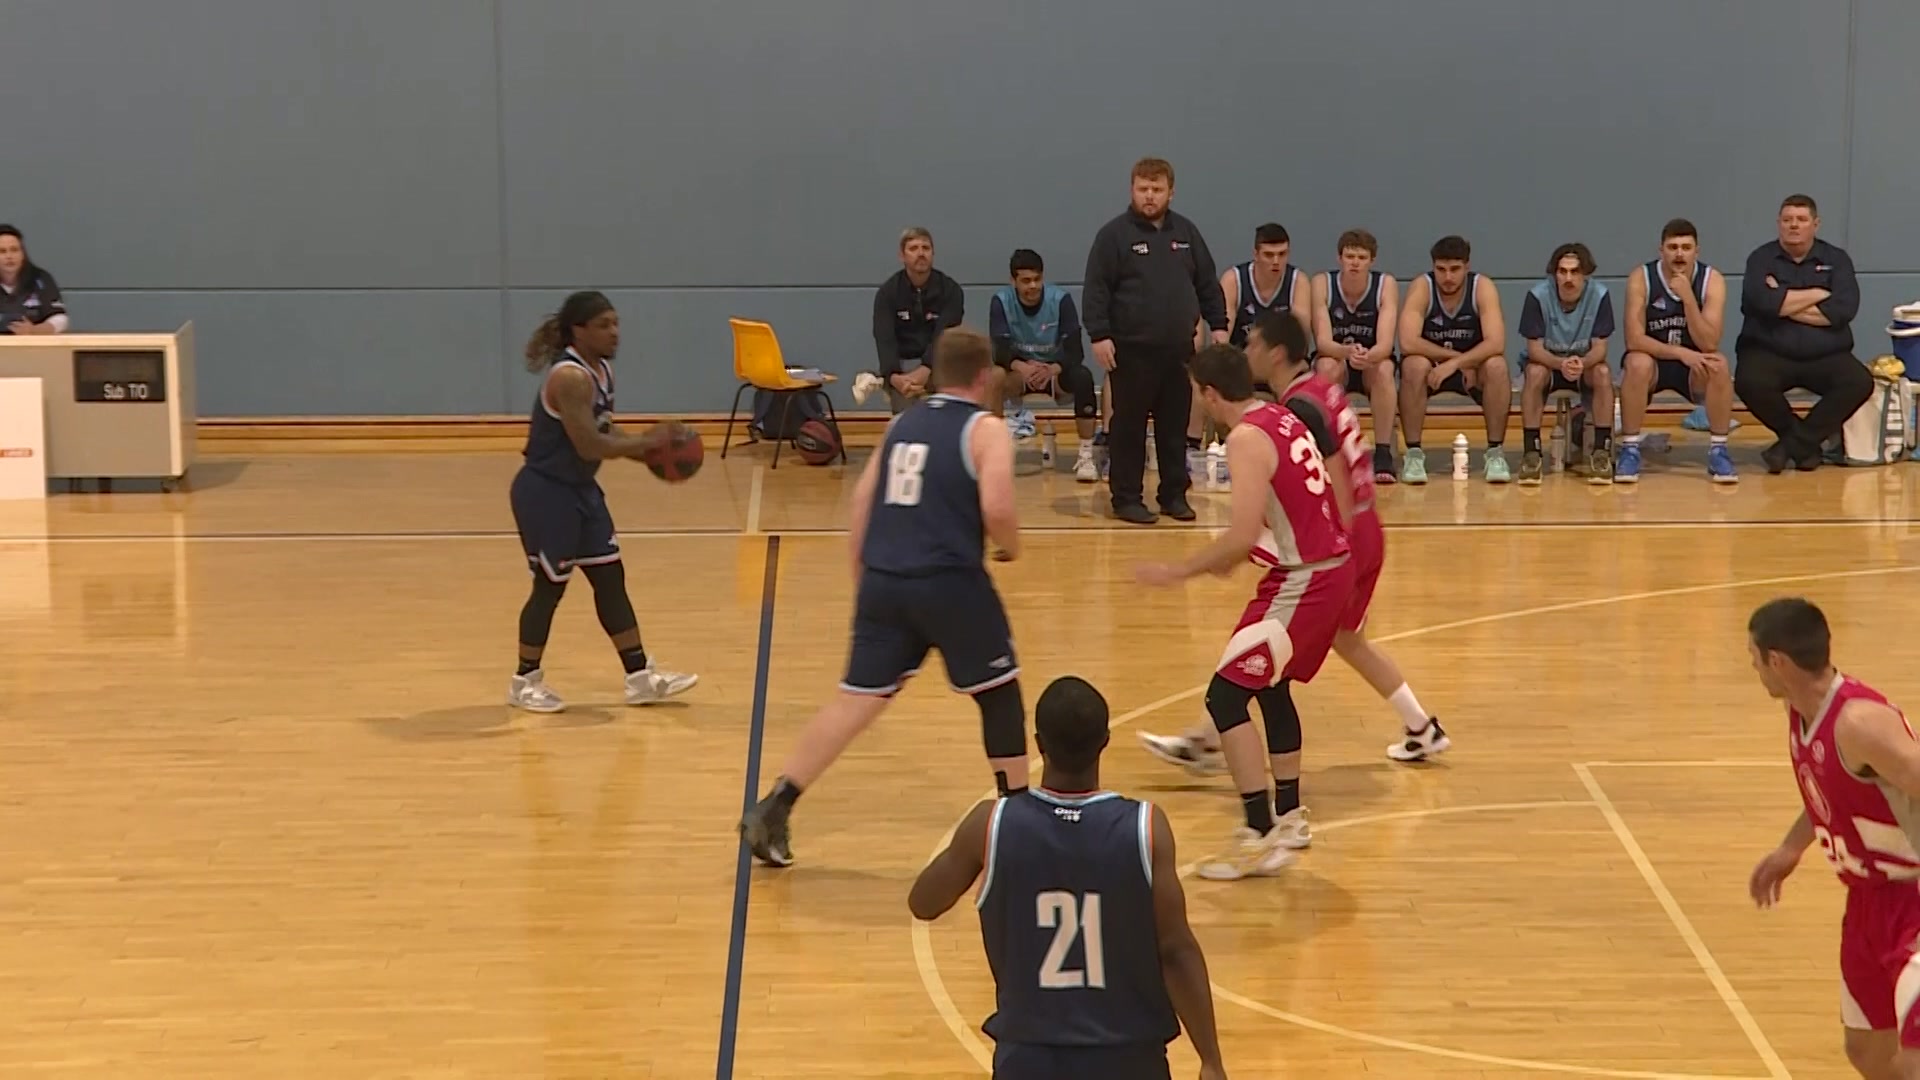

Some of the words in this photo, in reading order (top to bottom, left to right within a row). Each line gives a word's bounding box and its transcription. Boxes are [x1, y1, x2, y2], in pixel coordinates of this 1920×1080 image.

[103, 383, 125, 399] Sub
[884, 442, 930, 505] 18
[1036, 890, 1106, 989] 21
